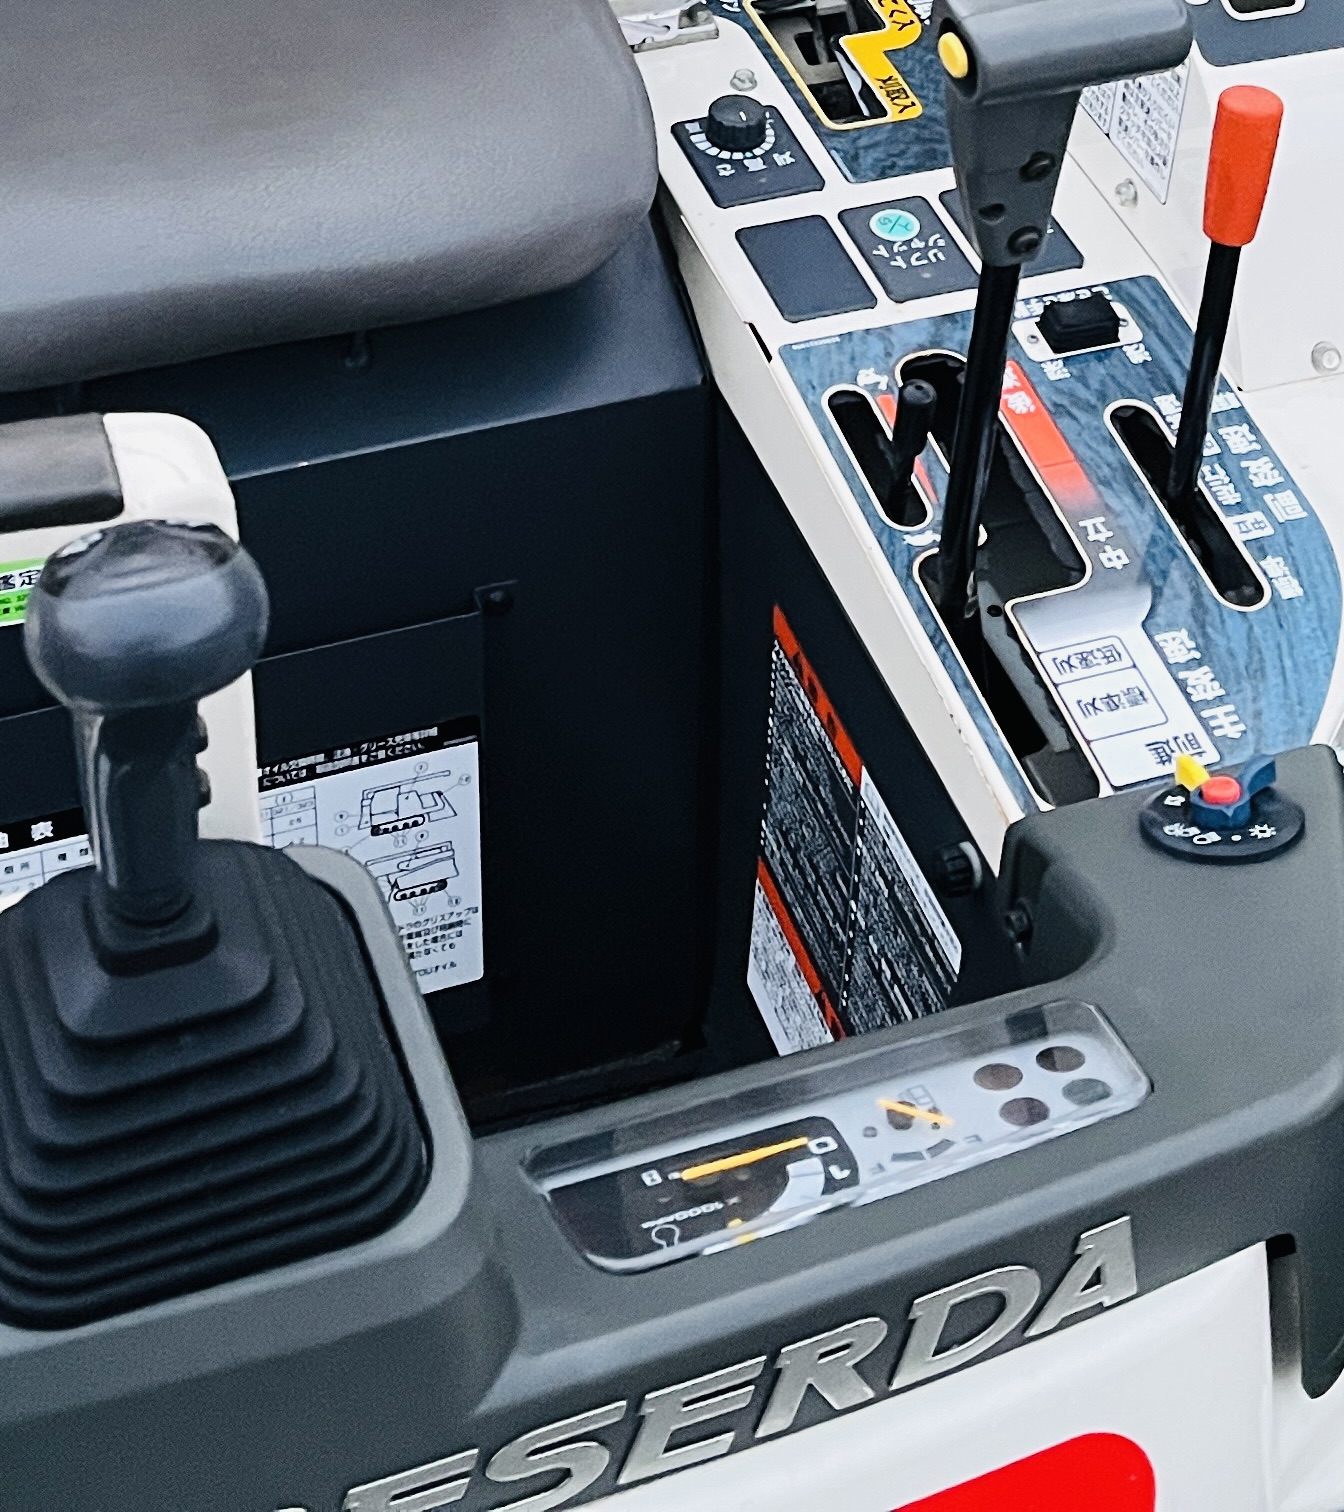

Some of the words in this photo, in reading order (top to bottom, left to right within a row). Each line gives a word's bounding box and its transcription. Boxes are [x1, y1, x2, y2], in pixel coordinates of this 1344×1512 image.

[891, 247, 946, 269] リフト
[1078, 516, 1131, 571] 中立
[1052, 642, 1128, 677] 低速刈
[1078, 685, 1151, 721] 標準刈
[1154, 629, 1247, 741] 主変速
[1146, 732, 1207, 768] 前進
[273, 1216, 1139, 1512] ESERDA
